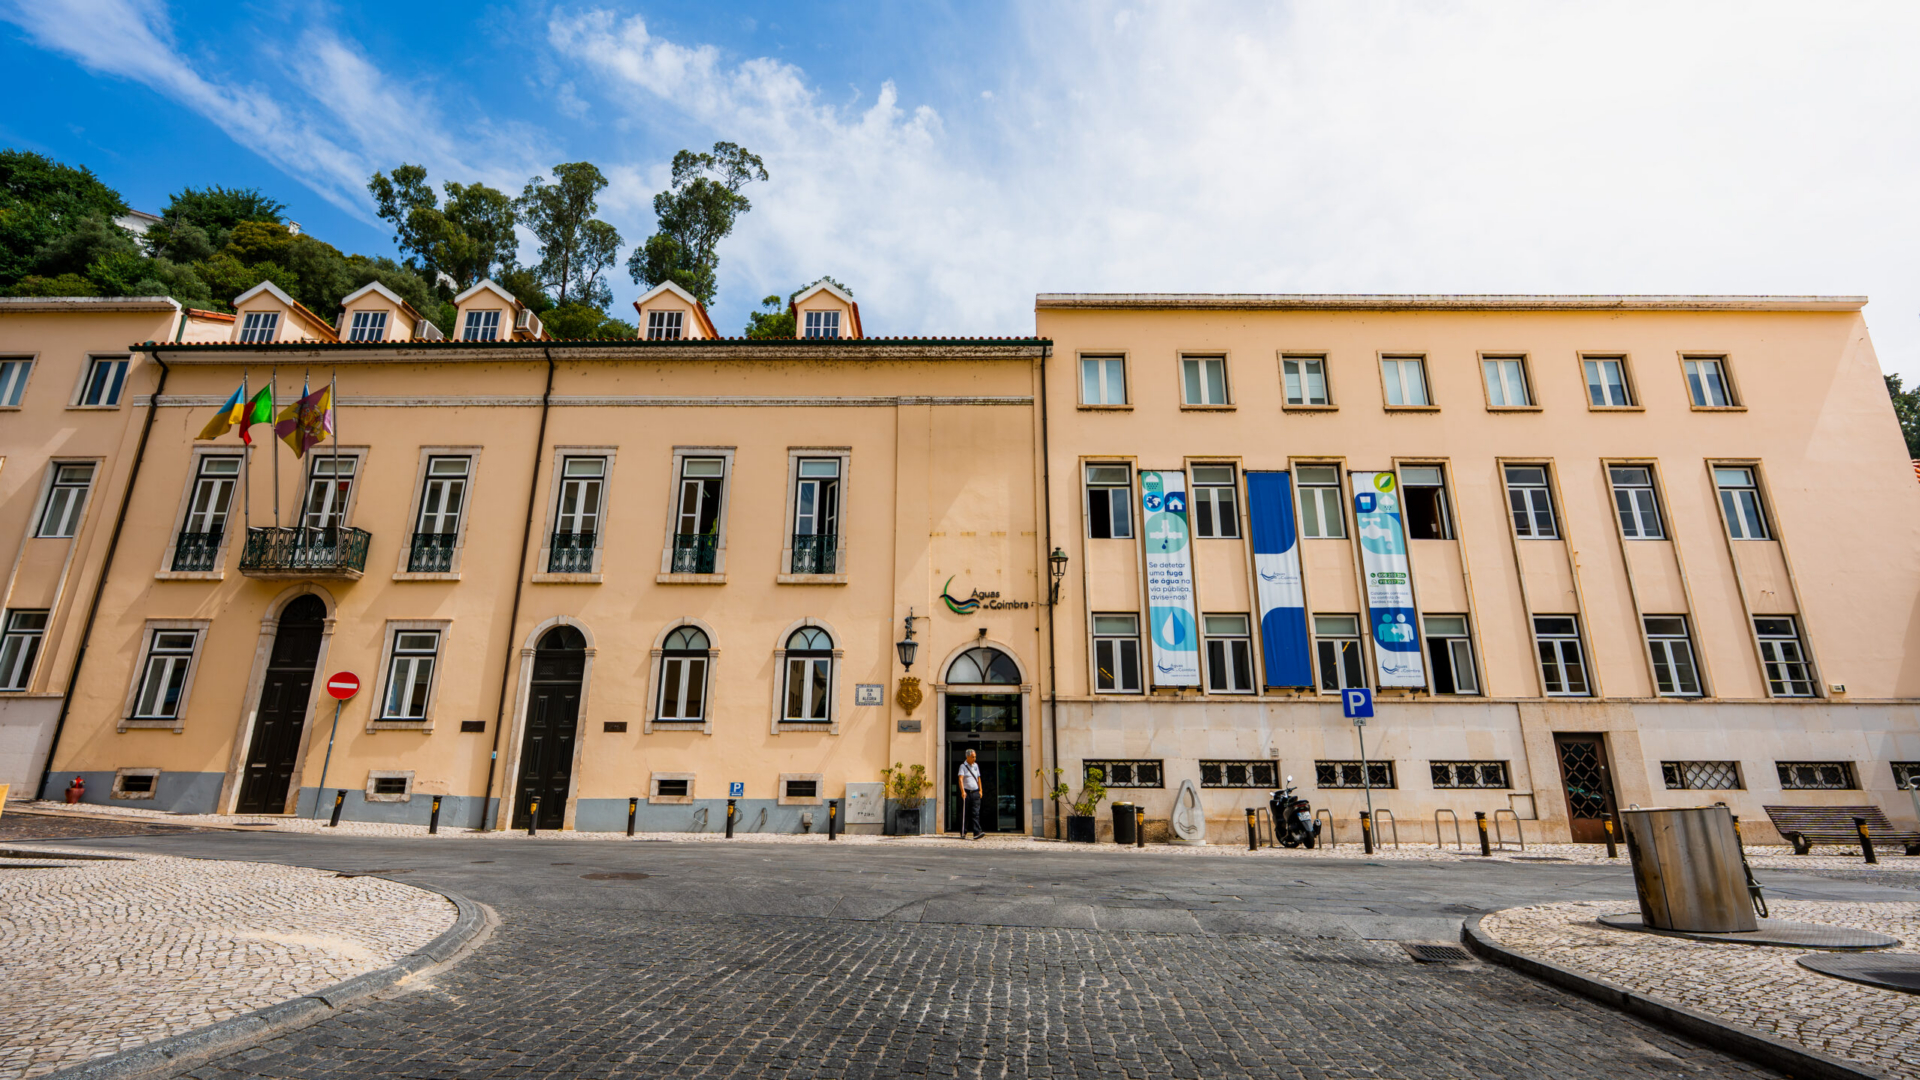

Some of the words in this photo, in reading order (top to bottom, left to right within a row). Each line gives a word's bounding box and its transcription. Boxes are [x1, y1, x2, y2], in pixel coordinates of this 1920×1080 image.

[971, 587, 1000, 600] Águas
[989, 599, 1029, 610] Coimbra
[1348, 691, 1366, 715] P
[734, 782, 741, 792] P
